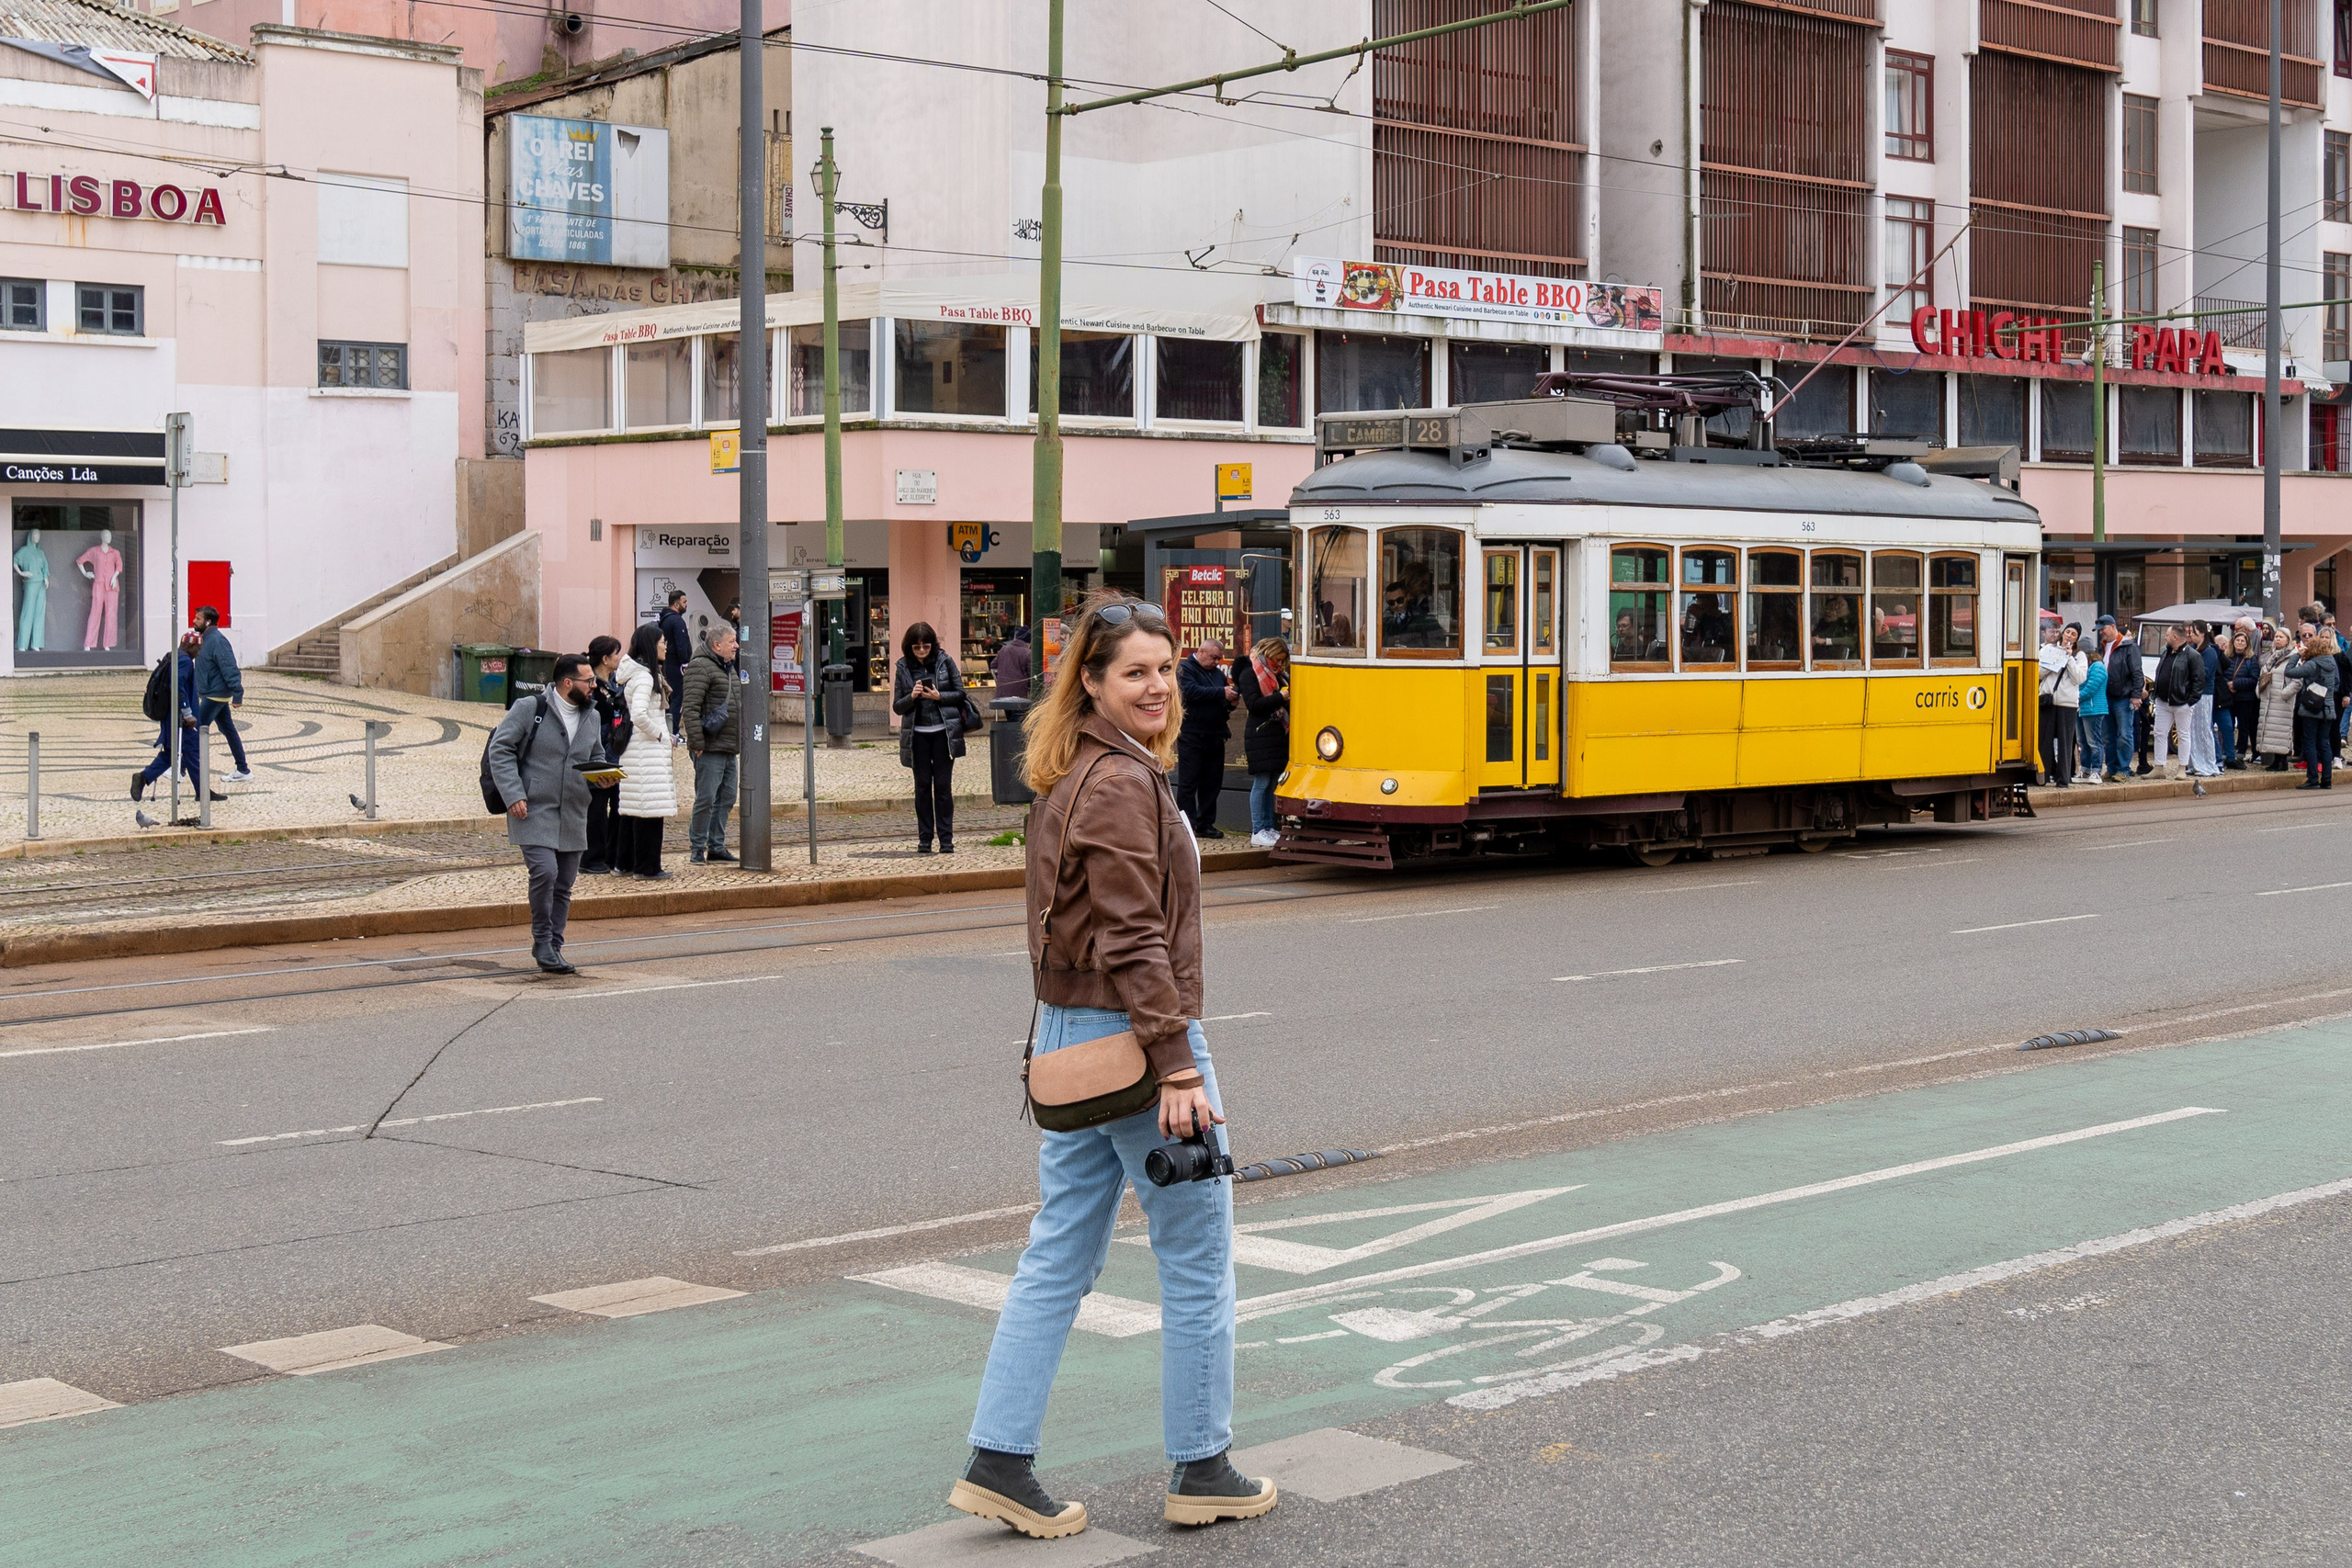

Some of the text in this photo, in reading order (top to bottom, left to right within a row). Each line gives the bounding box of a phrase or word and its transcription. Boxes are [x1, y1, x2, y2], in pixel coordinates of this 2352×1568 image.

[560, 140, 594, 162] REI
[546, 161, 584, 178] das
[14, 171, 227, 226] LISBOA
[518, 177, 605, 203] CHAVES
[785, 186, 793, 219] CHAVES
[585, 219, 597, 228] DE
[568, 241, 587, 250] 1865
[598, 282, 643, 301] DAS
[1409, 272, 1581, 315] Pasa Table BBQ
[940, 305, 1032, 325] Pasa Table BBQ
[1408, 300, 1434, 310] Authentic
[1434, 302, 1453, 311] Newari
[1453, 304, 1472, 313] Cuisine
[1483, 307, 1508, 316] Barbecue
[1515, 310, 1530, 318] Table
[603, 322, 658, 342] Pasa Table BBQ
[662, 325, 685, 335] Authentic
[702, 321, 720, 331] Cuisine
[719, 320, 730, 329] and
[1060, 318, 1205, 336] entic Newari Cuisine and Barbecue on Table
[1910, 304, 2226, 376] CHICHI PAPA
[1417, 419, 1442, 442] 28
[6, 465, 98, 482] Canções Lda
[1323, 509, 1340, 521] 563
[958, 525, 978, 536] ATM
[1801, 521, 1815, 532] 563
[659, 534, 729, 549] Reparação
[1191, 568, 1223, 581] Betclic
[1181, 590, 1234, 607] CELEBRA O
[1181, 607, 1234, 625] ANO NOVO
[1915, 684, 1959, 708] carris
